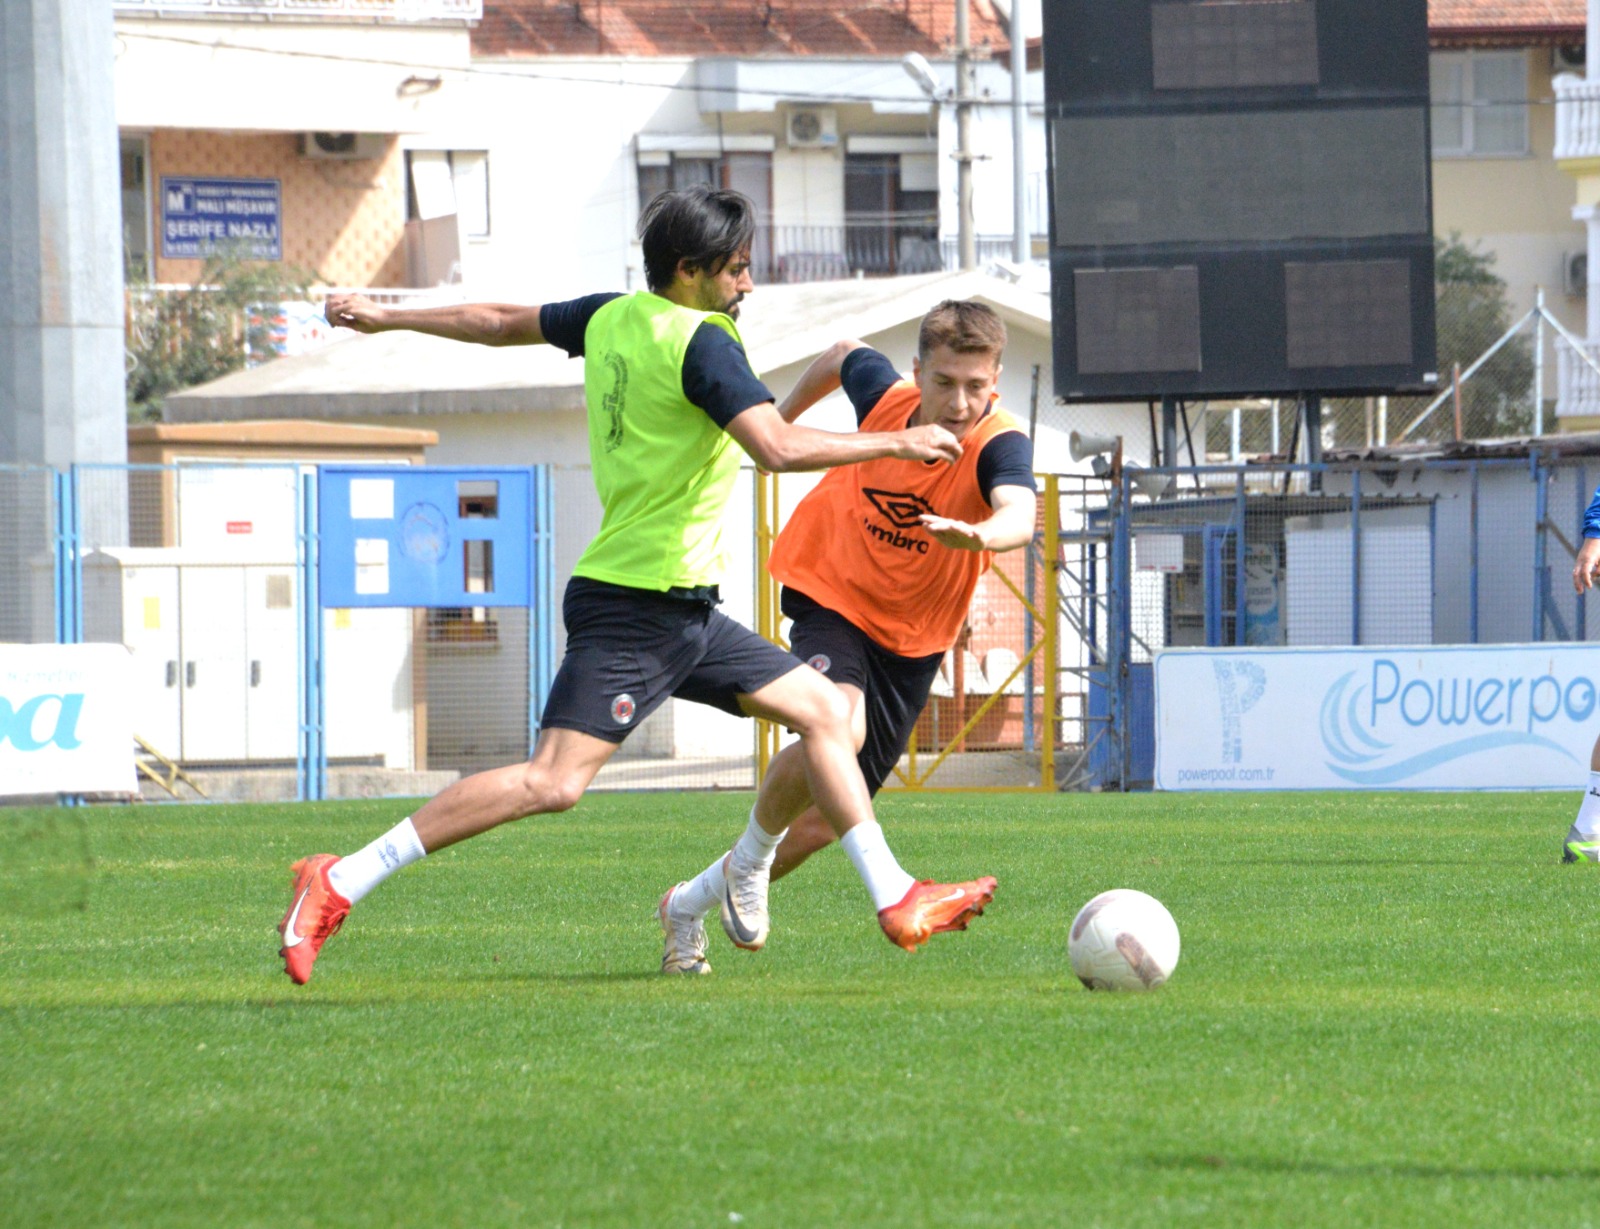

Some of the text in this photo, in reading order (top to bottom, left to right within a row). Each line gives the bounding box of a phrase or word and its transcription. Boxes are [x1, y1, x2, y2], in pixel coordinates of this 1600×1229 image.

[167, 218, 277, 240] ŞERİFE NAZLI
[1371, 658, 1600, 734] Powerpo
[1178, 767, 1275, 784] powerpool.com.tr
